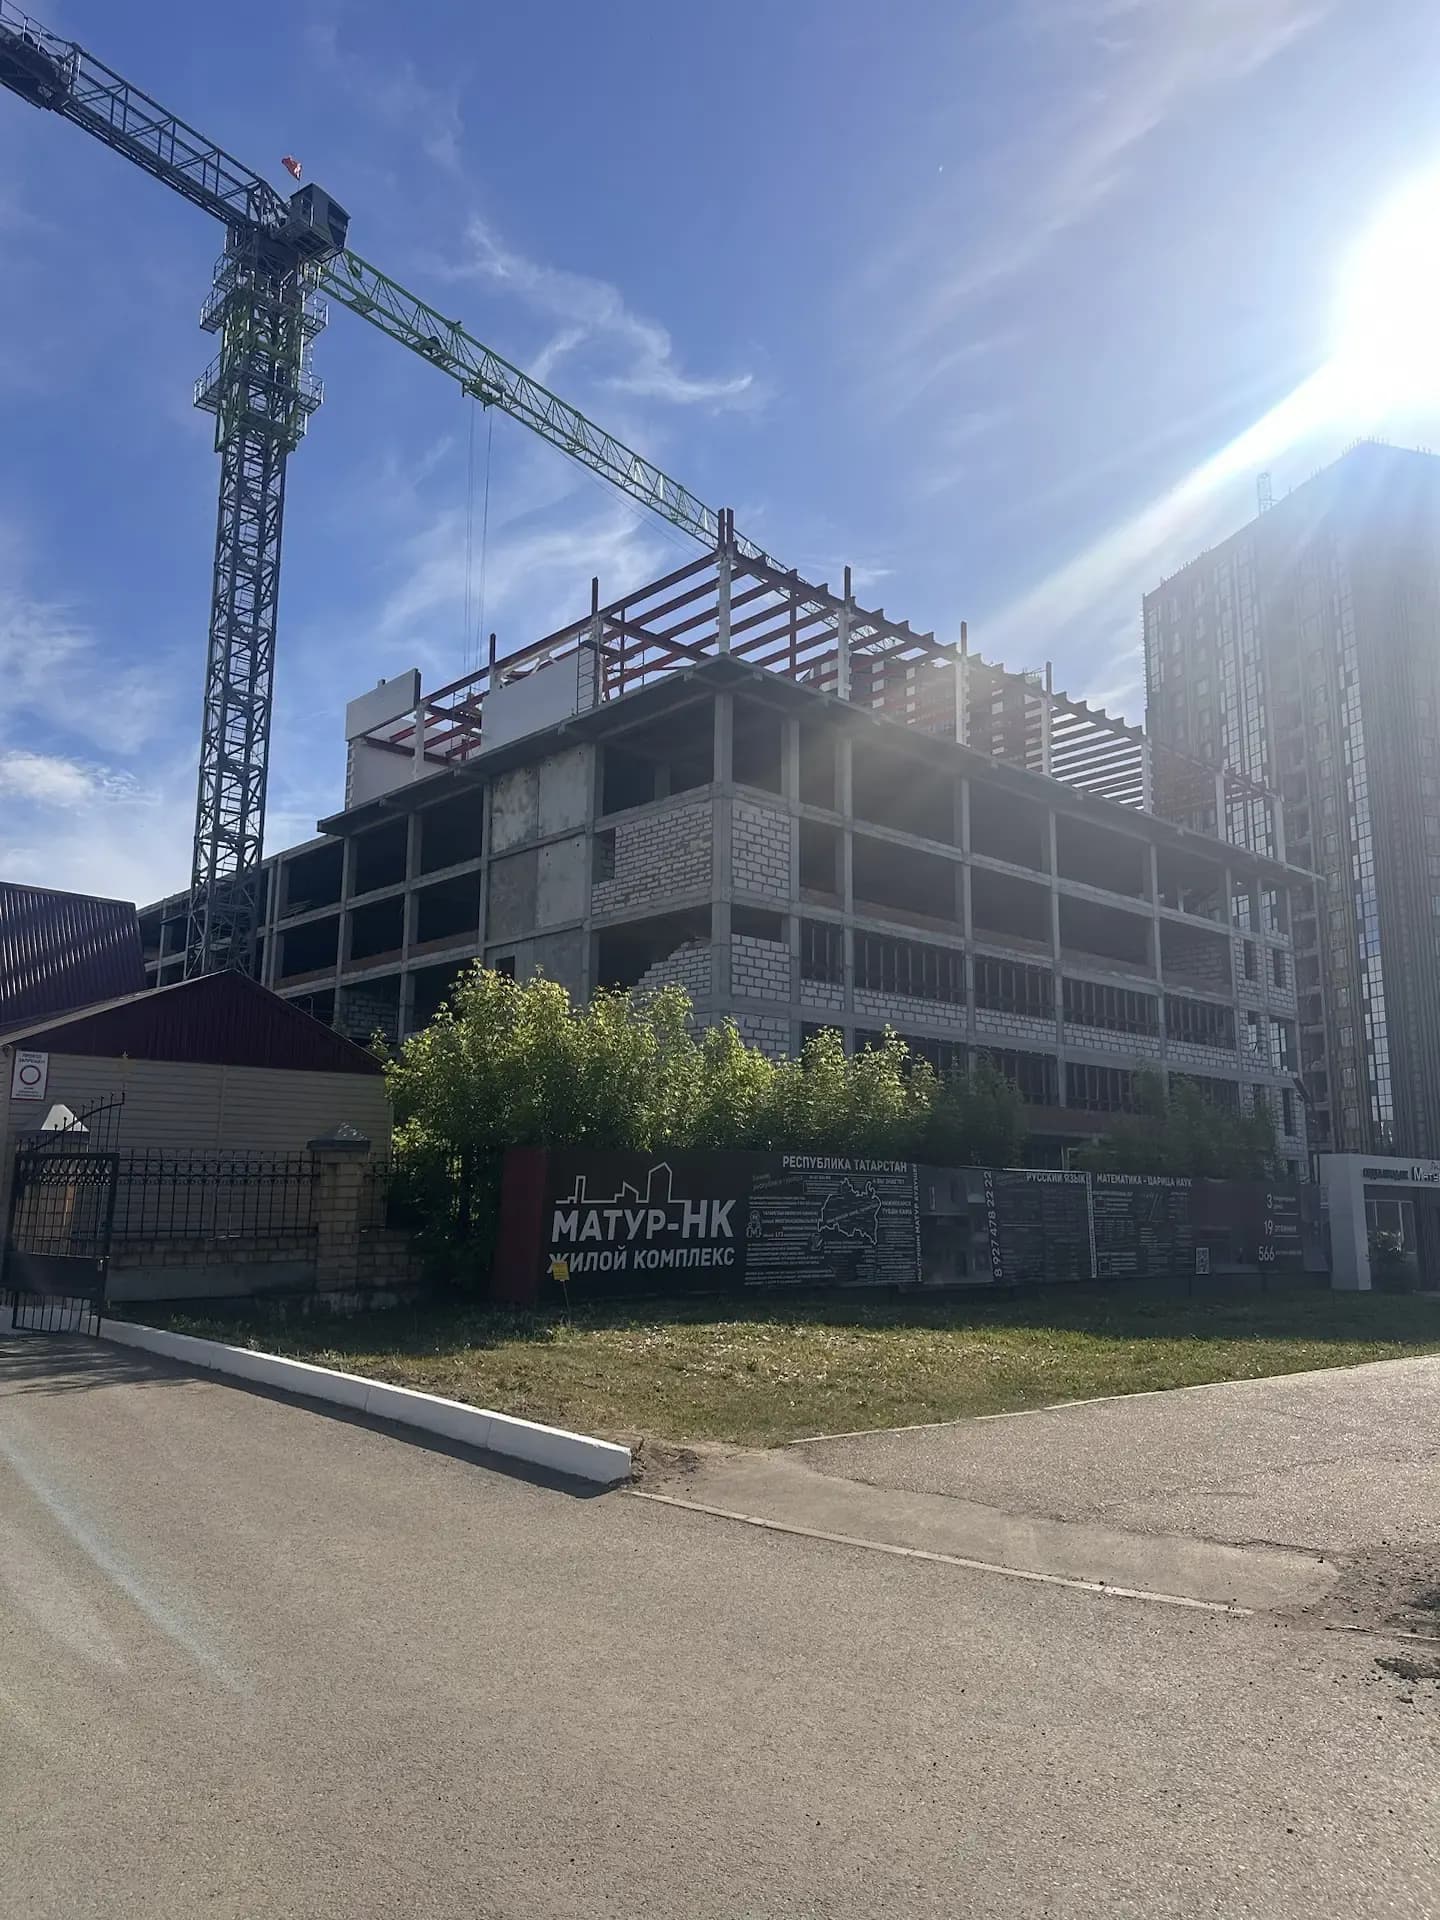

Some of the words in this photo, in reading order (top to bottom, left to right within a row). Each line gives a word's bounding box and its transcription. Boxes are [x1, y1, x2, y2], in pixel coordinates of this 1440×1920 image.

[782, 1155, 851, 1170] РЕСПУБЛИКА
[853, 1159, 907, 1173] ТАТАРСТАН
[984, 1170, 993, 1187] 22
[1096, 1172, 1143, 1185] МАТЕМАТИКА
[986, 1190, 995, 1208] 22
[1266, 1193, 1273, 1209] 3
[550, 1199, 737, 1243] МАТУР-НК
[988, 1211, 998, 1237] 478
[1264, 1219, 1273, 1235] 19
[546, 1245, 627, 1274] ЖИЛОЙ
[633, 1247, 736, 1270] КОМПЛЕКС
[991, 1239, 1001, 1265] 927
[1258, 1245, 1275, 1261] 566
[993, 1268, 1003, 1277] 8
